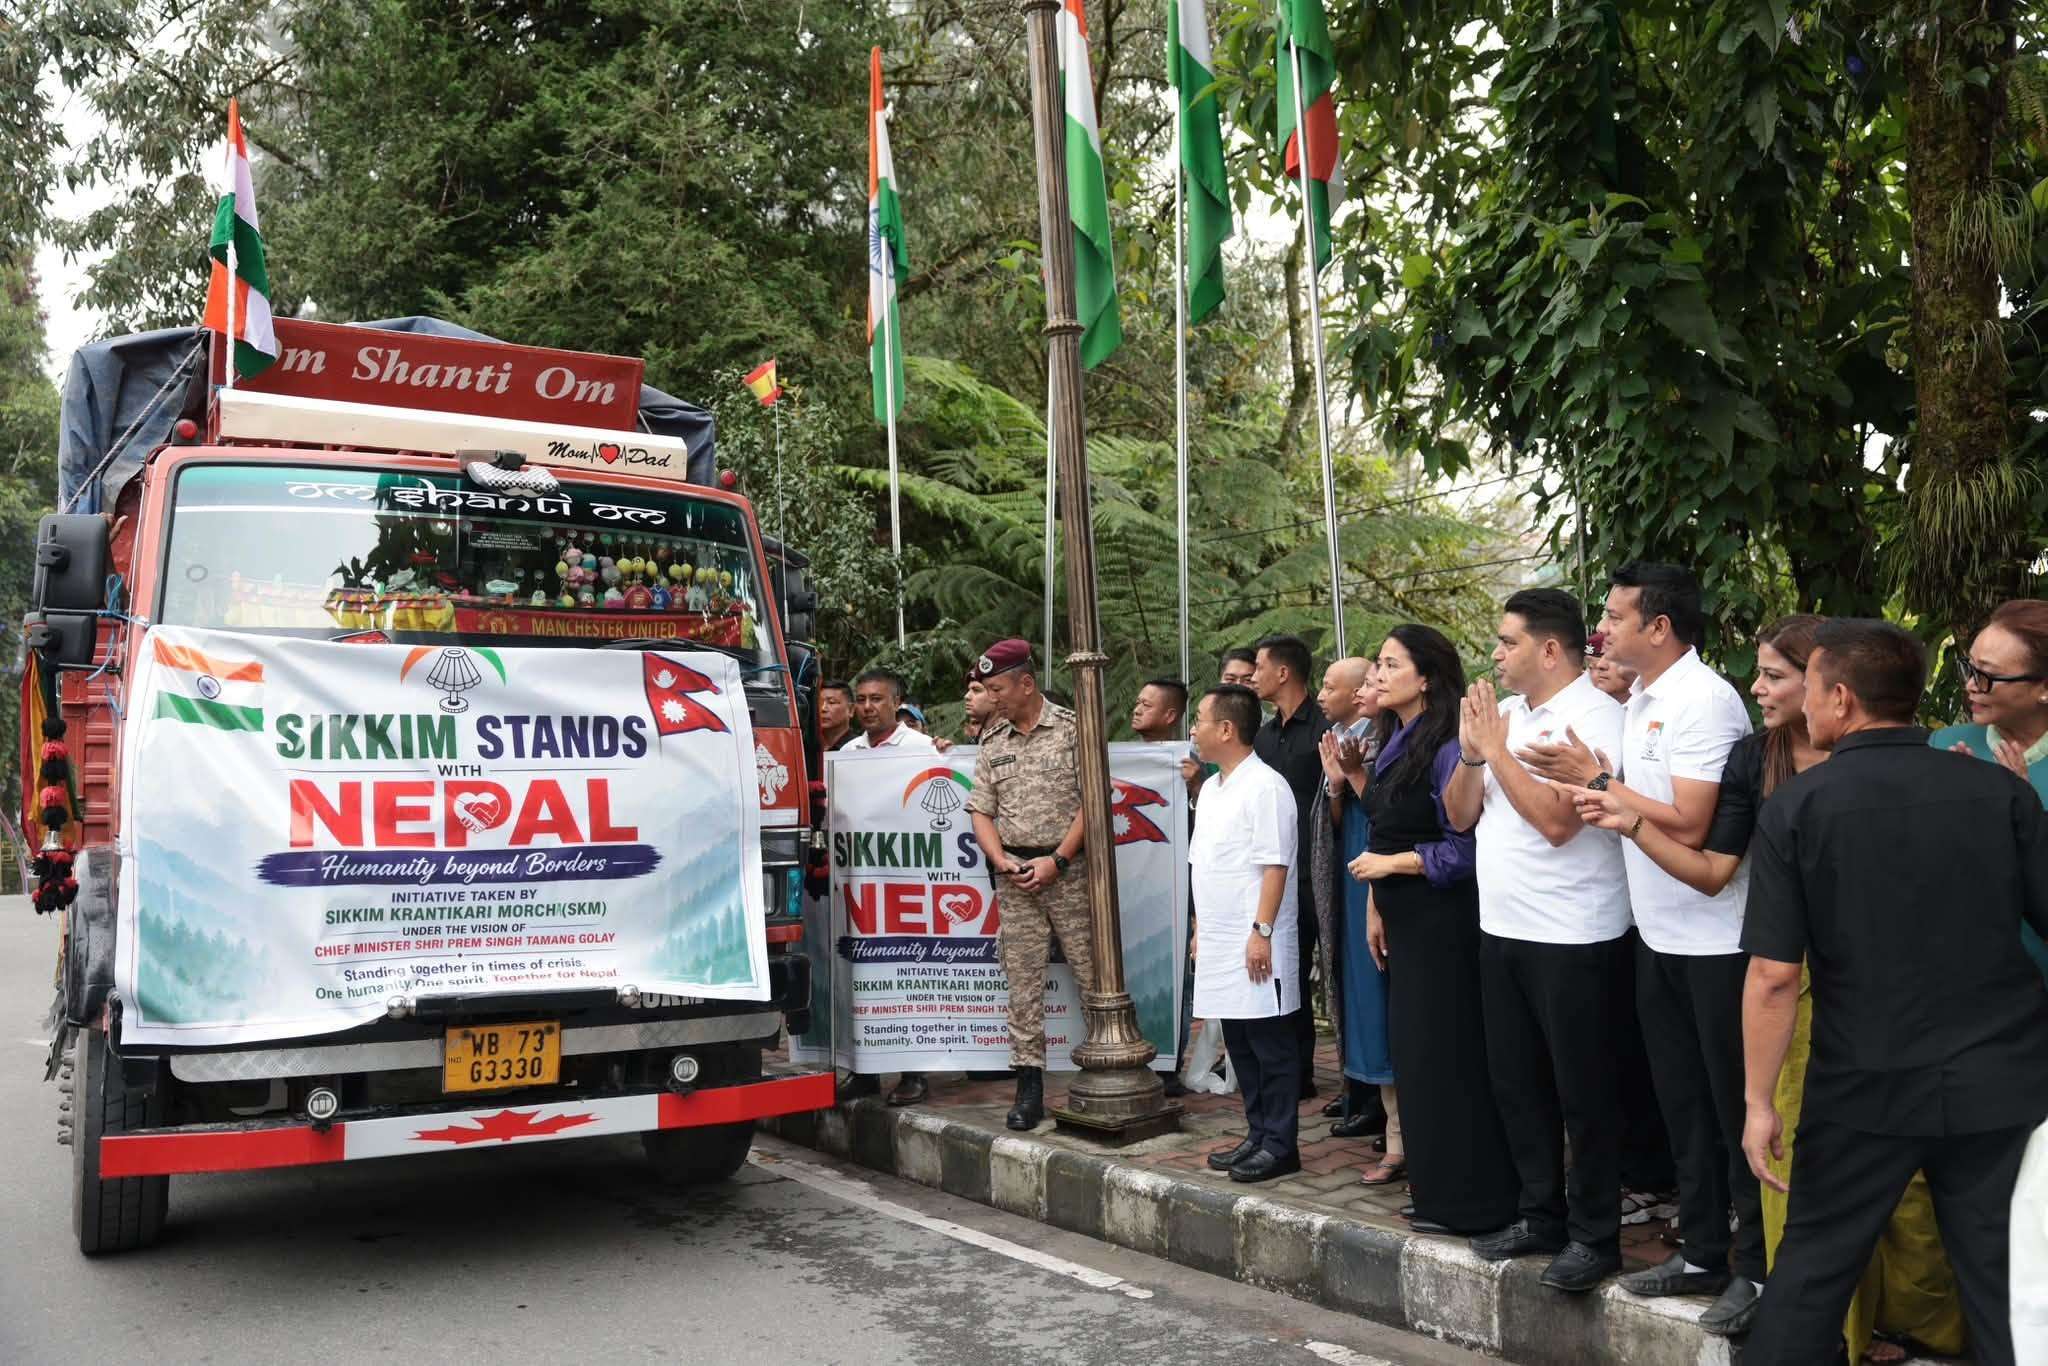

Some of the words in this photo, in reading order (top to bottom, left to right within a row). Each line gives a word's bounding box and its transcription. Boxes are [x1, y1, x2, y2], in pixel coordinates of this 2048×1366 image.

[274, 339, 326, 374] m
[352, 346, 512, 394] Shanti
[535, 366, 616, 406] Om
[547, 441, 591, 460] Mom
[628, 448, 671, 467] Dad
[531, 616, 624, 638] MANCHESTER
[628, 620, 677, 638] UNITED
[275, 713, 458, 760] SIKKIM
[476, 714, 647, 760] STANDS
[438, 764, 482, 777] WITH
[289, 778, 638, 848] NEPAL
[834, 832, 943, 868] SIKKIM
[321, 854, 438, 885] Humanity
[443, 855, 519, 885] beyond
[525, 851, 607, 876] Borders
[927, 872, 960, 881] WITH
[392, 891, 465, 903] INITIATIVE
[470, 890, 515, 901] TAKEN
[520, 889, 537, 900] BY
[325, 908, 384, 925] SIKKIM
[391, 905, 492, 921] KRANTIKARI
[843, 883, 1000, 935] NEP
[402, 926, 441, 936] UNDER
[446, 924, 467, 935] THE
[471, 924, 508, 934] VISION
[511, 923, 526, 933] OF
[315, 944, 351, 957] CHIEF
[354, 940, 411, 954] MINISTER
[415, 939, 443, 950] SHRI
[448, 938, 482, 949] PREM
[486, 936, 522, 947] SINGH
[527, 934, 575, 945] TAMANG
[579, 933, 615, 944] GOLAY
[852, 940, 927, 962] Humanity
[931, 941, 989, 962] beyond
[344, 966, 406, 981] Standing
[410, 963, 467, 977] together
[472, 961, 484, 972] in
[488, 960, 526, 972] times
[530, 959, 543, 970] of
[547, 958, 586, 969] crisis.
[897, 967, 949, 977] INITIATIVE
[952, 968, 986, 977] TAKEN
[989, 968, 1001, 977] BY
[315, 987, 342, 1000] One
[493, 971, 552, 983] Together
[557, 970, 575, 979] for
[853, 980, 893, 992] SIKKIM
[897, 980, 968, 991] KRANTIKARI
[974, 980, 1009, 991] MORC
[906, 994, 935, 1002] UNDER
[937, 994, 952, 1002] THE
[871, 1005, 913, 1015] MINISTER
[916, 1004, 937, 1013] SHRI
[940, 1005, 964, 1013] PREM
[967, 1005, 994, 1013] SINGH
[1044, 1005, 1067, 1013] OLAY
[864, 1024, 908, 1035] Standing
[912, 1023, 954, 1034] together
[957, 1023, 967, 1032] in
[970, 1023, 1001, 1032] times
[1001, 1024, 1008, 1032] o
[471, 1032, 499, 1056] WB
[518, 1030, 545, 1054] 73
[864, 1036, 914, 1047] humanity.
[916, 1035, 937, 1044] One
[940, 1035, 968, 1046] spirit.
[972, 1035, 1008, 1046] Togeth
[1046, 1035, 1070, 1046] epal.
[470, 1057, 543, 1083] G3330
